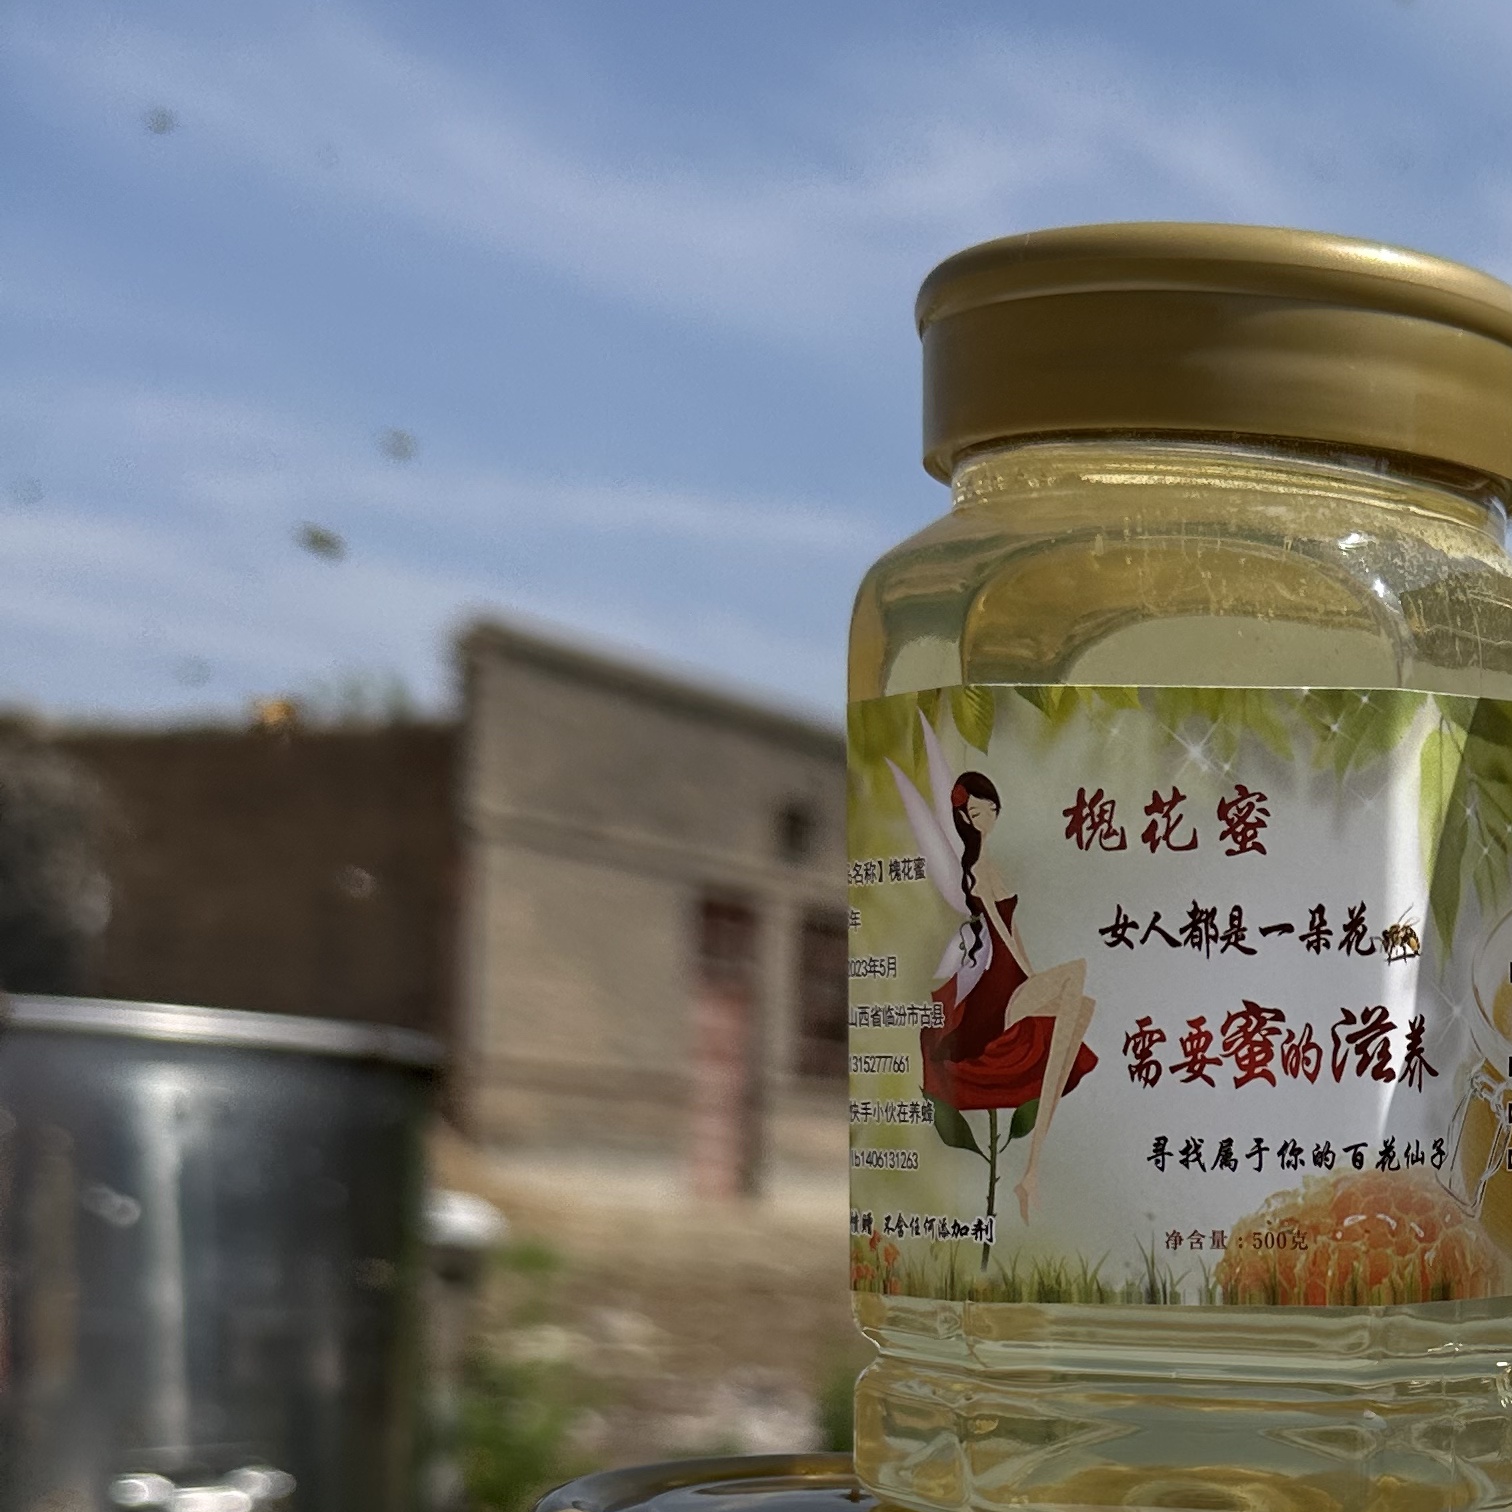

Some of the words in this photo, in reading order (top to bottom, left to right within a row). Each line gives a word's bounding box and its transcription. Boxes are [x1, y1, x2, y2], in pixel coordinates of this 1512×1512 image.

[1063, 783, 1272, 856] 槐花蜜
[1099, 900, 1377, 960] 女人都是一朵花
[1123, 1000, 1439, 1093] 需要蜜的滋养
[1147, 1136, 1449, 1174] 寻找属于你的百花仙子
